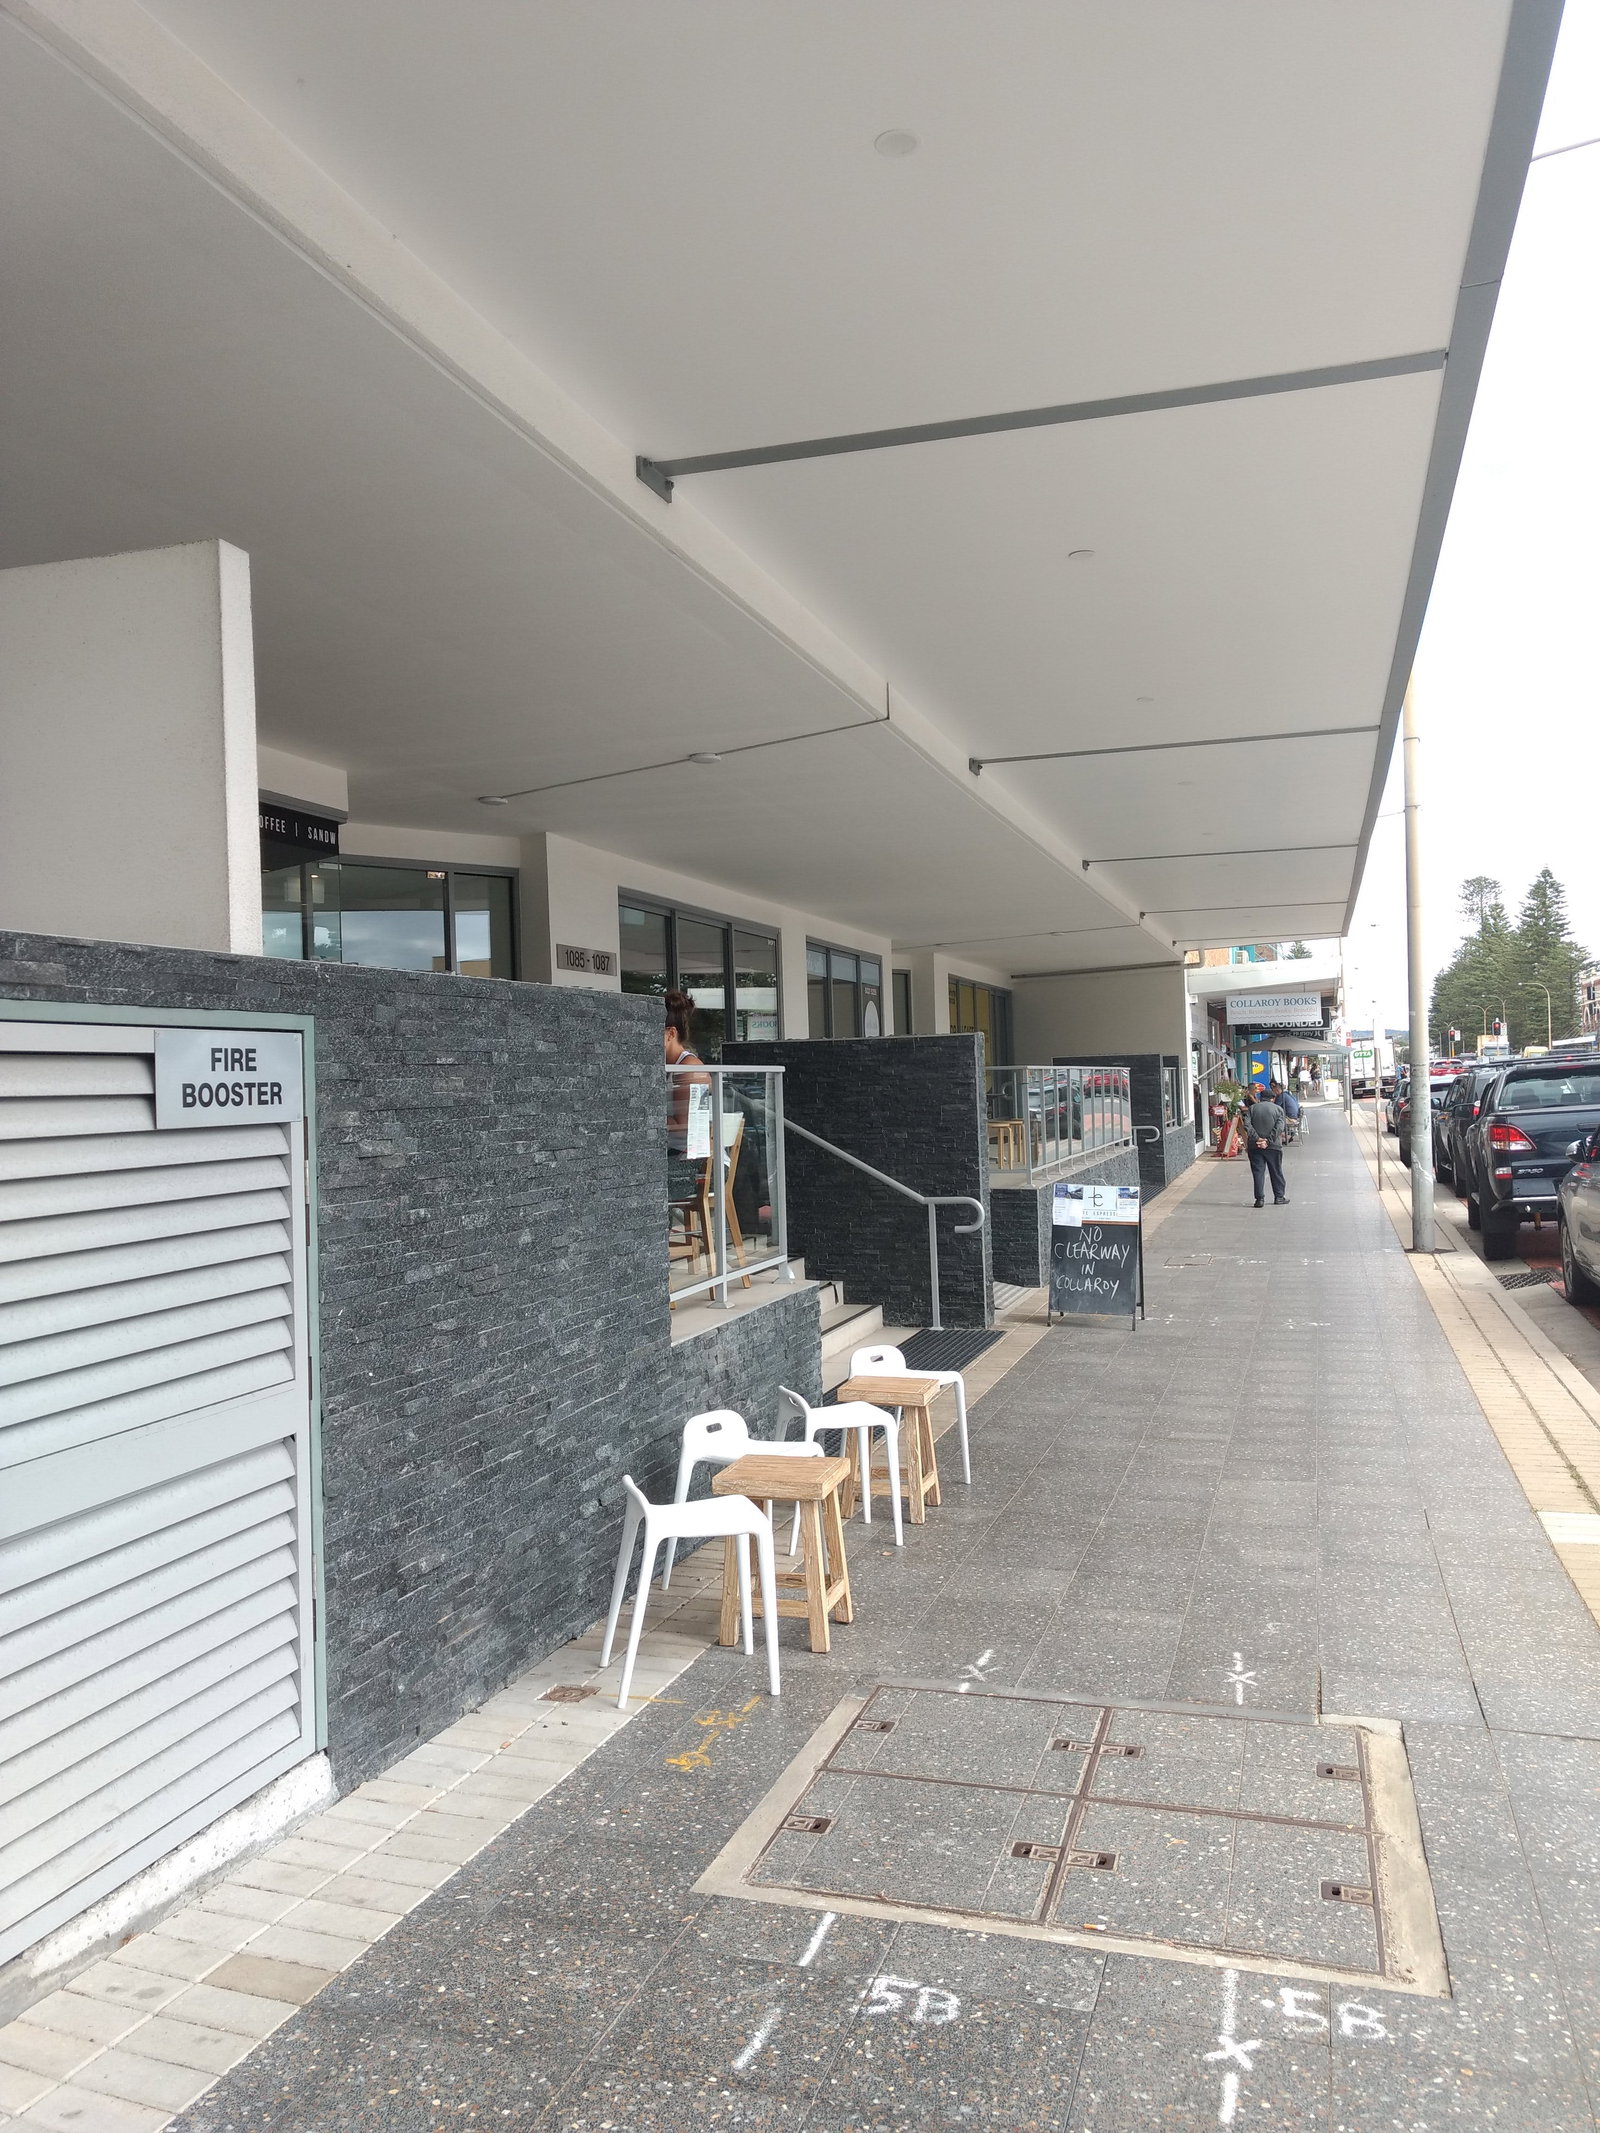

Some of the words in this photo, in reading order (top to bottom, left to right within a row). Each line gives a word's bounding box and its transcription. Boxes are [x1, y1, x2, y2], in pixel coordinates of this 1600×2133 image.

[307, 826, 336, 845] SANDW
[565, 949, 585, 968] 1085
[592, 953, 610, 971] 1087
[1230, 999, 1280, 1008] COLLAROY
[1283, 997, 1317, 1006] BOOKS
[211, 1048, 257, 1071] FIRE
[182, 1082, 283, 1108] BOOSTER
[1079, 1226, 1103, 1244] NO
[1054, 1241, 1130, 1269] CLEARWAY
[1081, 1261, 1096, 1275] IN
[1056, 1275, 1120, 1300] COLLAROY
